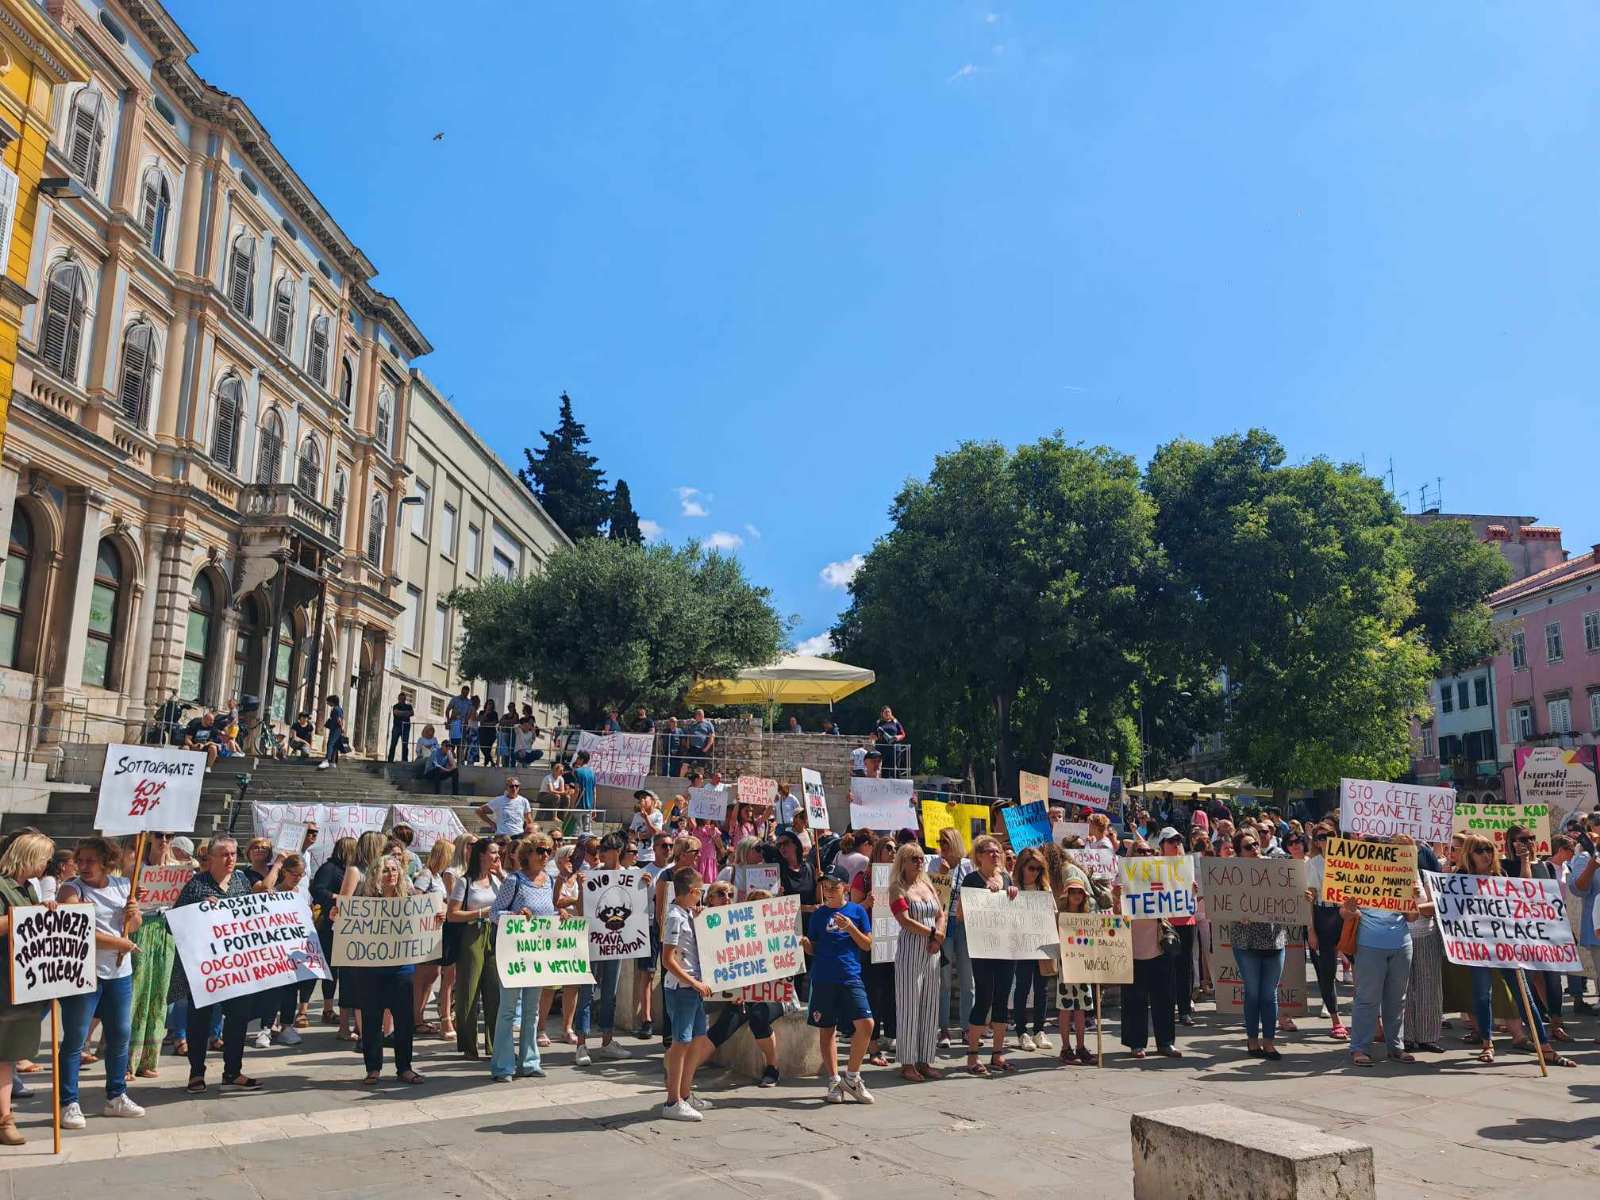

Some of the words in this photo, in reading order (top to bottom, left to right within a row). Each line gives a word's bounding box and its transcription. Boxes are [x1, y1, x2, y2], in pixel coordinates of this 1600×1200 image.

[114, 756, 195, 776] SOTTOPAGATE
[1055, 765, 1093, 780] PREDIVNO
[1059, 759, 1103, 774] ODGOJITELJ
[134, 779, 166, 799] 40%
[1068, 776, 1110, 792] ZANIMANJE
[1348, 781, 1373, 800] ŠTO
[1385, 786, 1420, 807] ĆETE
[1428, 792, 1454, 811] KAD
[128, 797, 160, 816] 29%
[1353, 801, 1423, 821] OSTANETE
[1431, 809, 1453, 826] BEZ
[1523, 805, 1549, 817] KAD
[1351, 817, 1453, 841] ODGOJITELJA?
[1327, 839, 1399, 862] LAVORARE
[1327, 858, 1360, 871] SCUOLA
[587, 874, 610, 892] OVO
[618, 874, 634, 887] JE
[1208, 866, 1243, 888] KAO
[1250, 867, 1271, 888] DA
[1278, 867, 1297, 888] SE
[1335, 871, 1376, 884] SALARIO
[141, 887, 180, 903] ZAKO
[1344, 885, 1402, 898] ENORME
[1430, 875, 1473, 896] NEĆE
[1476, 878, 1546, 899] MLADI
[198, 894, 257, 912] GRADSKI
[231, 904, 270, 919] PULA
[339, 896, 434, 918] NESTRUČNA
[1213, 894, 1233, 912] NE
[1436, 898, 1448, 914] U
[212, 911, 303, 939] DEFICITARNE
[340, 919, 413, 935] ZAMJENA
[506, 918, 525, 935] SVE
[705, 912, 722, 930] OD
[727, 906, 755, 925] MOJE
[590, 931, 625, 946] PRAVA
[725, 928, 740, 943] MI
[743, 923, 757, 938] SE
[1441, 919, 1484, 939] MALE
[1491, 919, 1550, 941] PLAĆE
[15, 936, 89, 968] PROMJENJIVO
[210, 942, 217, 955] I
[346, 937, 433, 960] ODGOJITELJ
[556, 936, 577, 949] SAM
[716, 940, 764, 965] NEMAM
[767, 936, 781, 953] NI
[783, 934, 798, 949] ZA
[1446, 940, 1492, 962] VELIKA
[1495, 942, 1578, 963] ODGOVORNOST
[200, 945, 287, 976] ODGOJITELJI
[507, 957, 526, 976] JOŠ
[533, 961, 542, 973] U
[713, 958, 768, 984] POŠTENE
[205, 971, 251, 993] OSTALI
